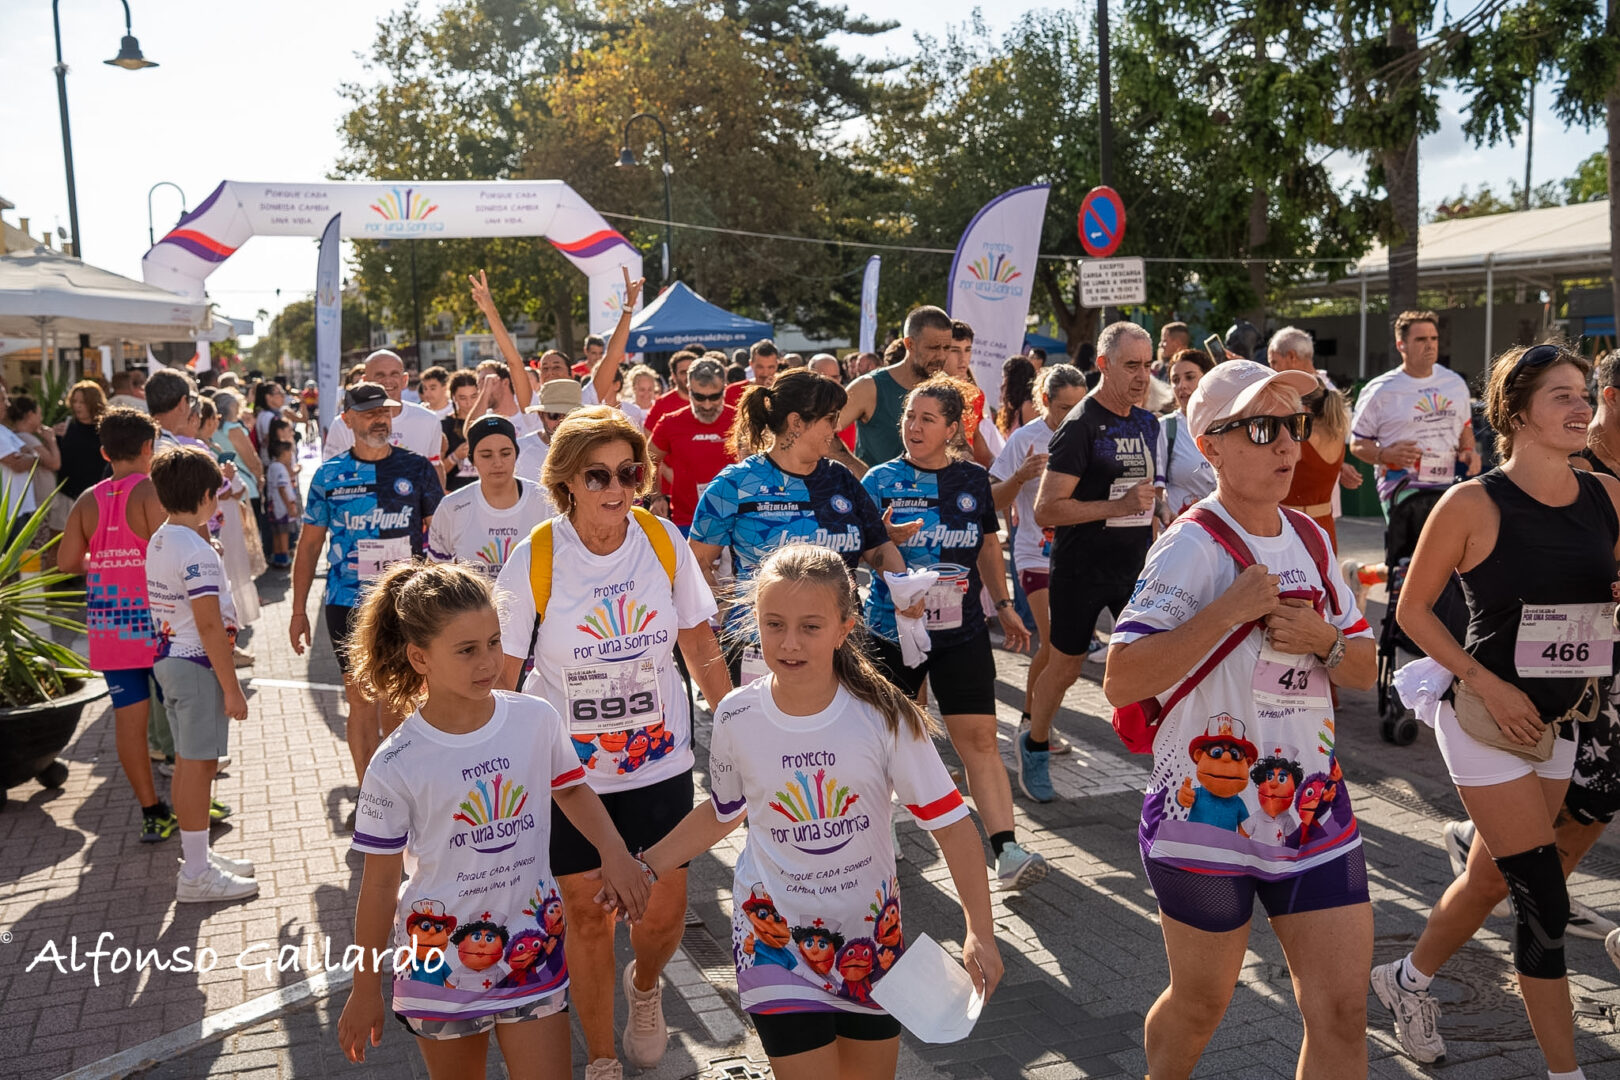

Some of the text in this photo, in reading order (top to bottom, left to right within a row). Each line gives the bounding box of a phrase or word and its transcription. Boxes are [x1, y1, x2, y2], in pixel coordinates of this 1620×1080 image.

[1114, 438, 1142, 454] XVI
[1430, 467, 1448, 476] 459
[370, 508, 412, 530] PUPAS
[930, 525, 979, 548] PUPAS
[593, 580, 635, 598] Proyecto
[1140, 596, 1186, 622] de Cádiz
[573, 629, 668, 659] Por una sonrisa
[1541, 643, 1590, 662] 466
[573, 691, 655, 720] 693
[461, 757, 510, 781] Proyecto
[782, 750, 836, 769] Proyecto
[471, 825, 494, 844] una
[770, 827, 790, 843] Por
[793, 823, 821, 842] una
[490, 865, 510, 876] CADA
[816, 868, 840, 879] CADA
[458, 887, 488, 898] CAMBIA
[489, 882, 506, 891] UNA
[819, 886, 837, 895] UNA
[840, 880, 858, 891] VIDA
